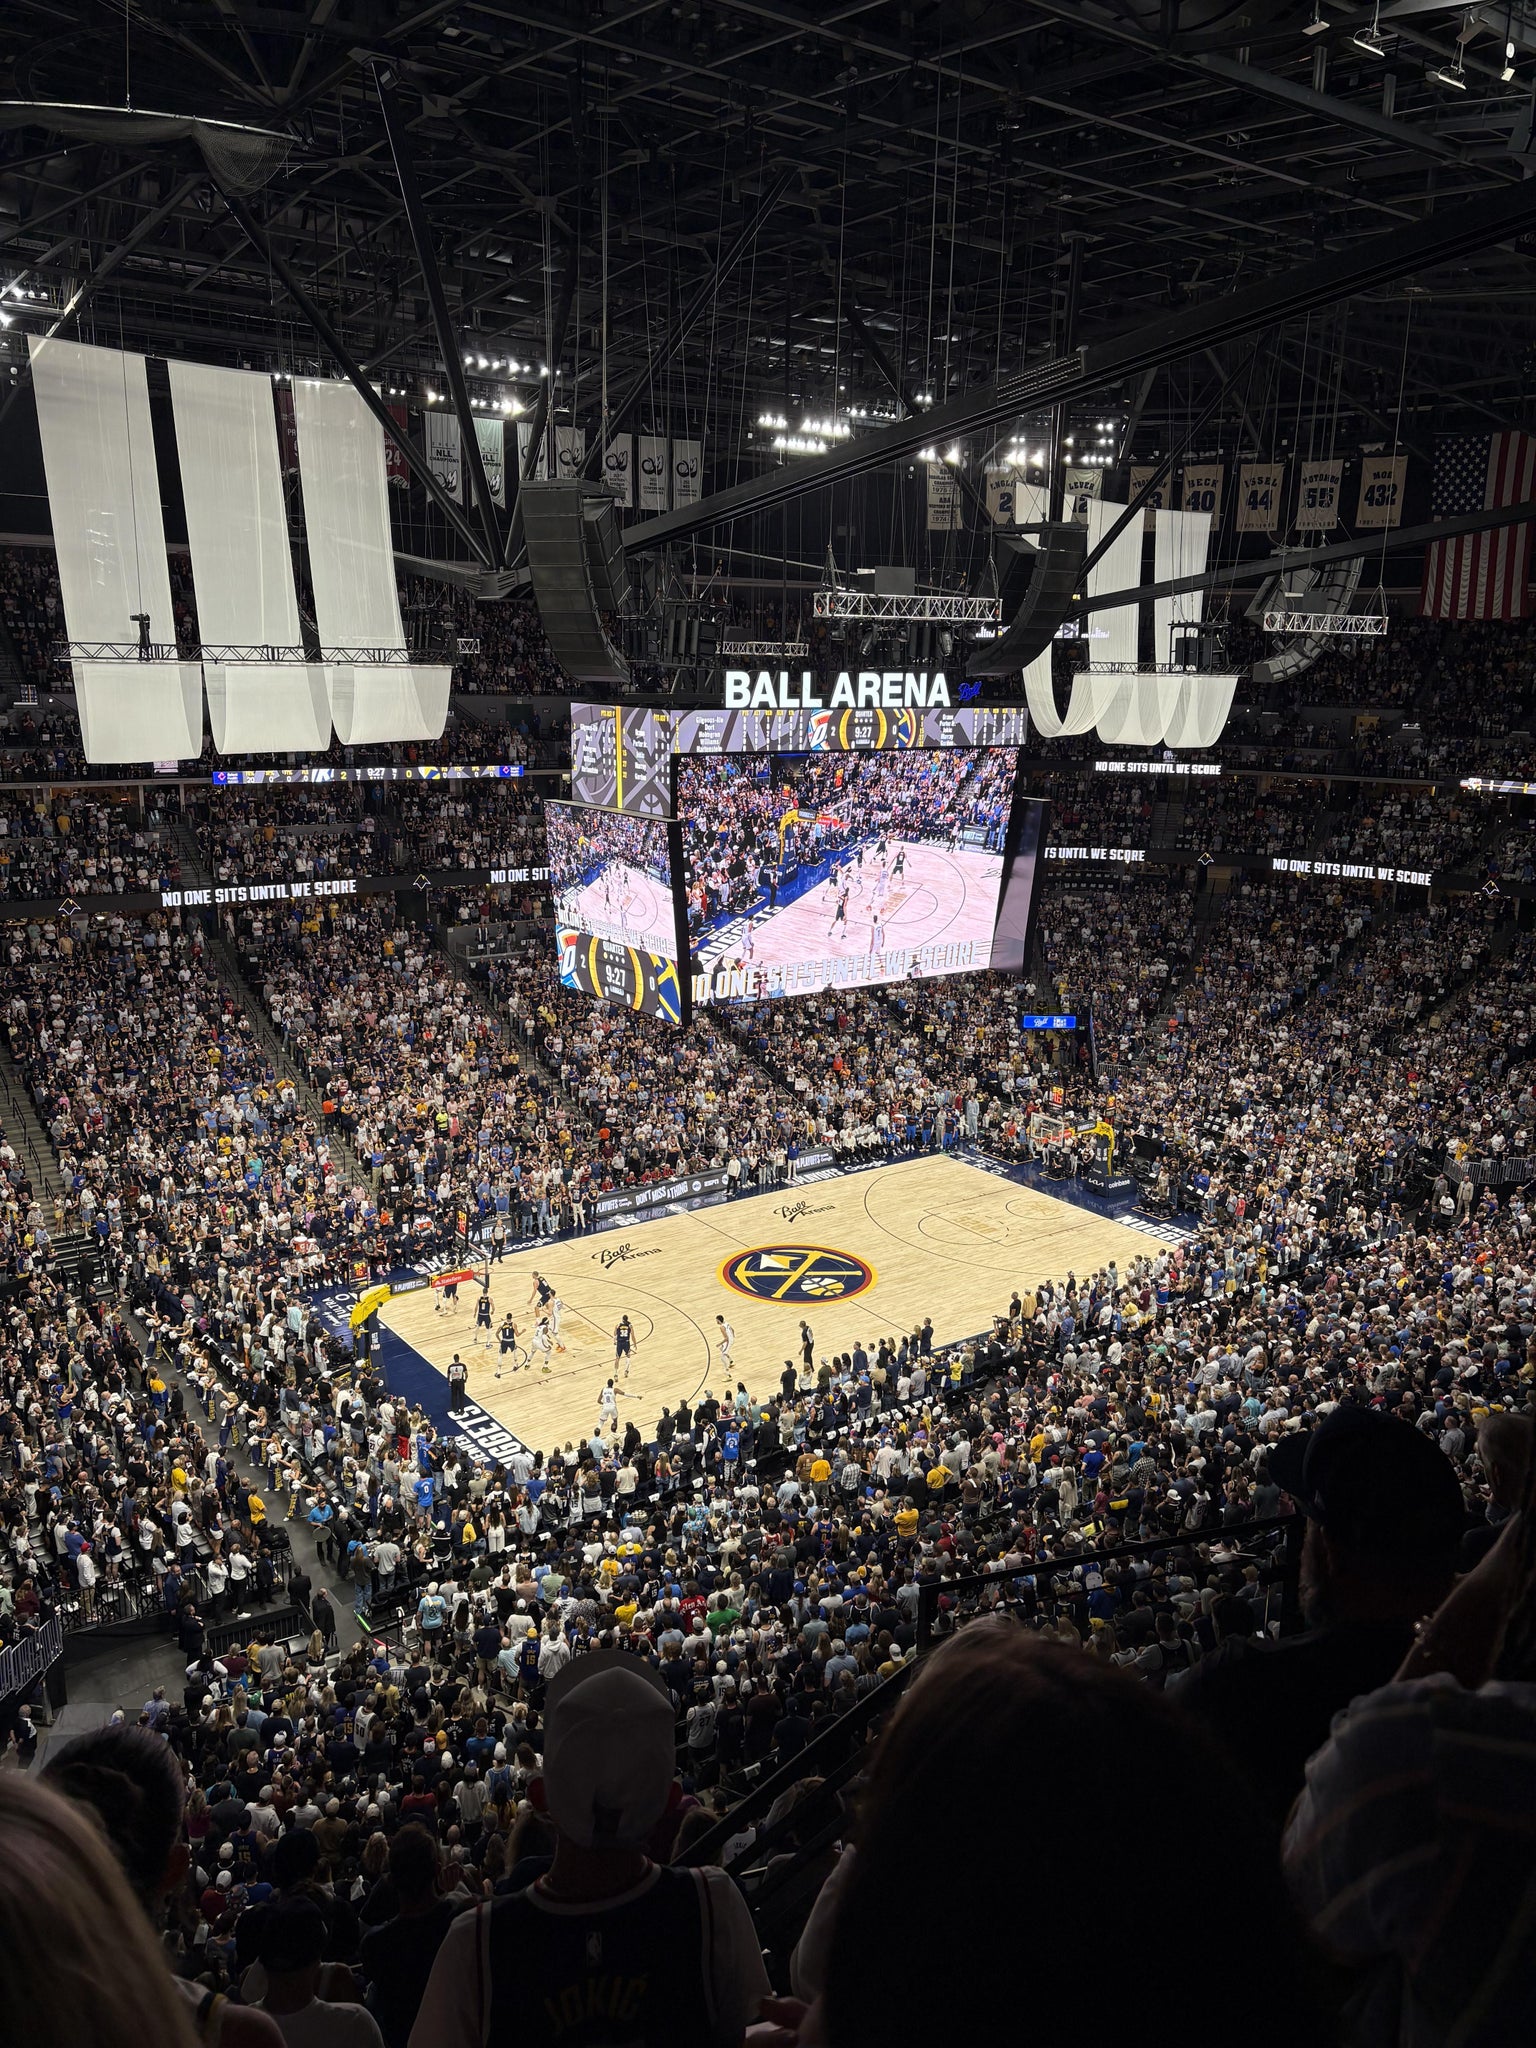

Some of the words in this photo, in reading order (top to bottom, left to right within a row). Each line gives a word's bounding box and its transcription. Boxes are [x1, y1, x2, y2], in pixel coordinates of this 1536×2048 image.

[436, 449, 453, 458] NLL
[1068, 482, 1095, 490] LEVER
[1188, 478, 1219, 488] BECK
[1244, 476, 1278, 488] ISSEL
[1187, 490, 1216, 511] 40
[1246, 489, 1273, 511] 44
[1304, 487, 1334, 508] 55
[1364, 483, 1398, 507] 432
[999, 492, 1012, 513] 2
[725, 671, 822, 708] BALL
[830, 672, 951, 708] ARENA
[958, 681, 982, 701] Ball
[831, 726, 836, 736] 2
[855, 726, 872, 738] 9:27
[892, 725, 897, 735] 0
[340, 771, 347, 779] 2
[367, 768, 385, 776] 9:27
[405, 769, 412, 778] 0
[1095, 761, 1107, 771] NO
[1108, 762, 1126, 772] ONE
[1127, 762, 1148, 773] SITS
[1149, 763, 1175, 774] UNTIL
[1176, 764, 1190, 774] WE
[1191, 764, 1222, 775] SCORE
[1058, 848, 1089, 859] UNTIL
[1090, 848, 1107, 860] WE
[1109, 849, 1145, 862] SCORE
[490, 869, 506, 884] NO
[508, 868, 530, 882] ONE
[1273, 858, 1288, 871] NO
[1289, 859, 1312, 873] ONE
[1313, 861, 1341, 876] SITS
[1342, 864, 1375, 879] UNTIL
[1377, 867, 1395, 881] WE
[1396, 869, 1432, 886] SCORE
[161, 891, 182, 907] NO
[184, 889, 212, 905] ONE
[214, 887, 247, 904] SITS
[249, 883, 290, 901] UNTIL
[291, 882, 312, 897] WE
[313, 879, 357, 896] SCORE
[602, 940, 626, 957] QUARTER
[580, 956, 587, 968] 2
[713, 965, 760, 999] ONE
[766, 961, 817, 992] SITS
[820, 952, 880, 985] UNTIL
[919, 939, 985, 971] SCORE
[605, 964, 626, 988] 9:27
[649, 976, 655, 991] 0
[1033, 1018, 1048, 1027] Ball
[800, 1154, 821, 1167] PLAYOFFS
[976, 1157, 1009, 1173] ULTRA
[792, 1168, 845, 1185] PLAYOFFS
[844, 1160, 888, 1172] Google
[1108, 1179, 1130, 1189] coinbase
[635, 1189, 652, 1205] DON'T
[651, 1186, 667, 1202] MISS
[671, 1181, 689, 1198] THING
[596, 1199, 618, 1212] PLAYOFFS
[774, 1201, 813, 1223] Ball
[801, 1204, 836, 1217] Arena
[1159, 1223, 1200, 1241] DENVER
[502, 1237, 553, 1252] Google
[591, 1243, 638, 1269] Ball
[620, 1247, 662, 1262] Arena
[619, 1329, 628, 1337] 32
[454, 1434, 492, 1464] DENVER
[729, 1441, 734, 1449] 2
[423, 1485, 429, 1494] 0
[571, 1500, 578, 1508] 15
[526, 1654, 536, 1665] 15
[699, 1715, 711, 1727] 27
[344, 1723, 353, 1734] 15
